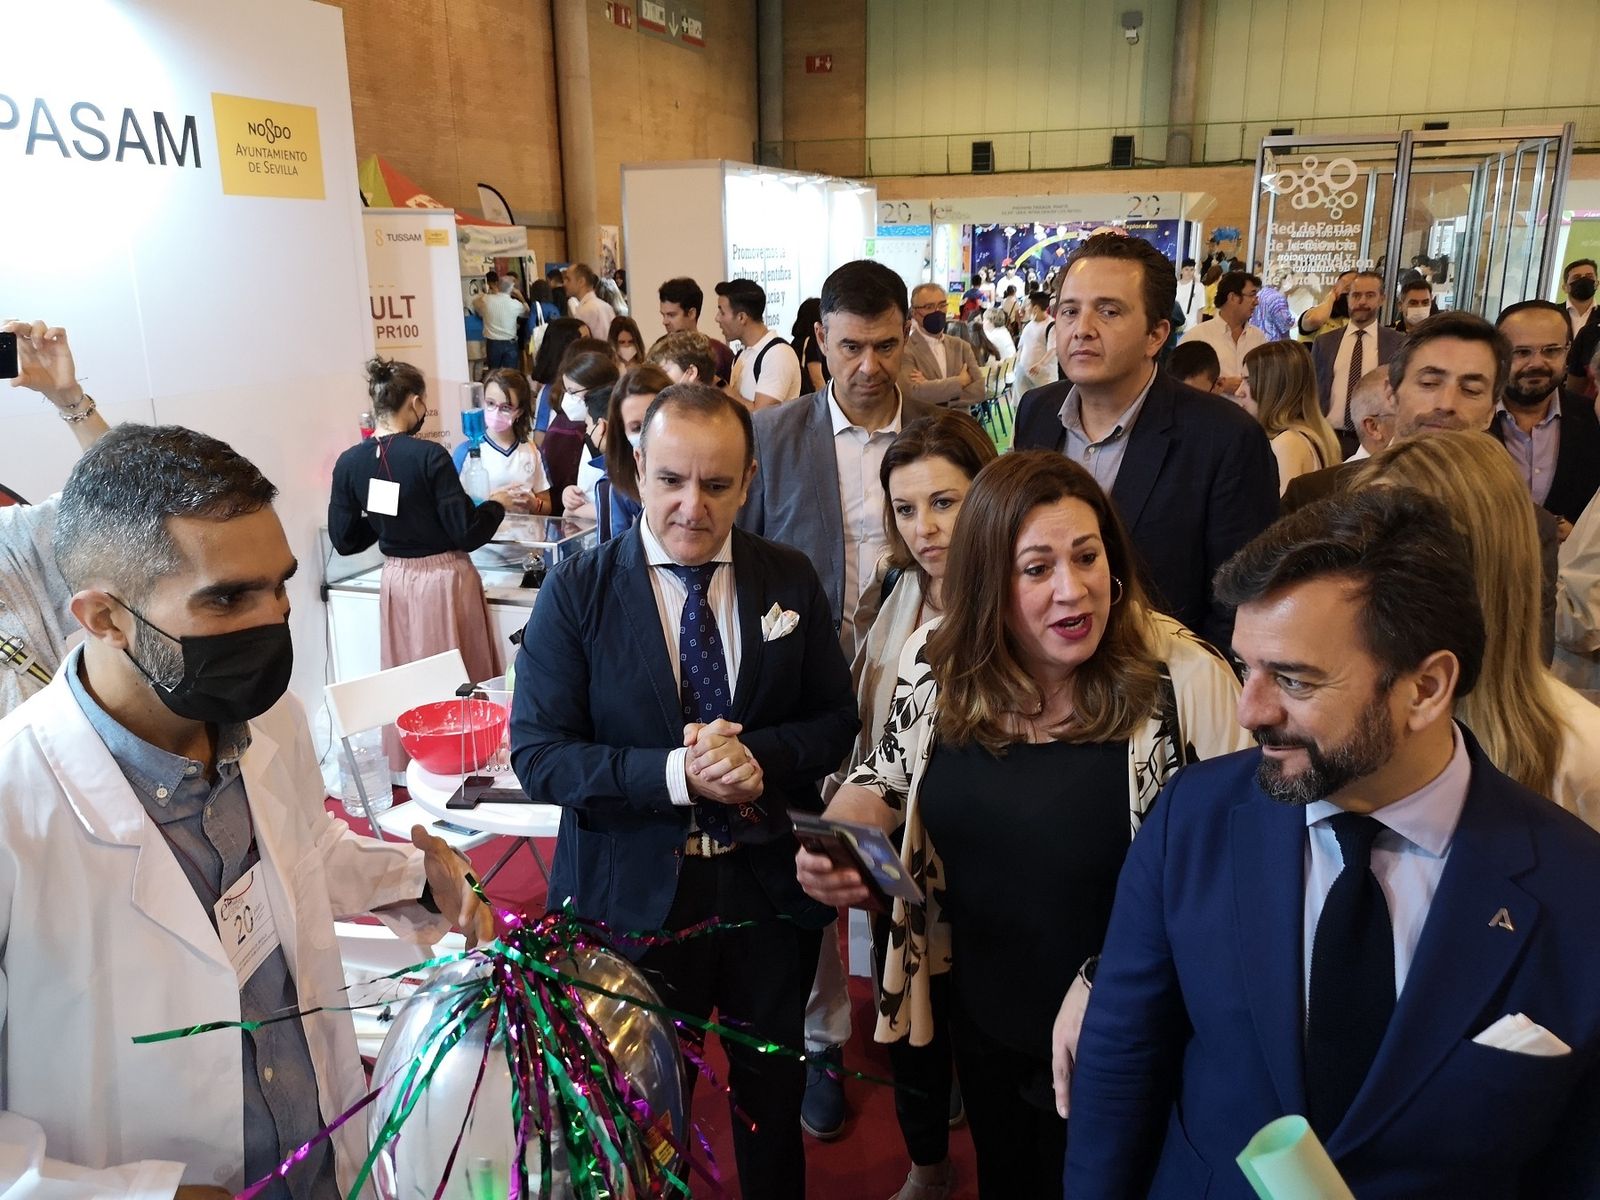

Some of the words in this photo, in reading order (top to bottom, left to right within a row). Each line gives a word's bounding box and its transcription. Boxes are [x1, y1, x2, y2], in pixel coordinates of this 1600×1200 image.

[1271, 222, 1296, 234] Red
[387, 233, 422, 242] TUSSAM
[370, 295, 416, 320] ULT
[376, 325, 419, 339] PR100
[234, 905, 254, 945] 20
